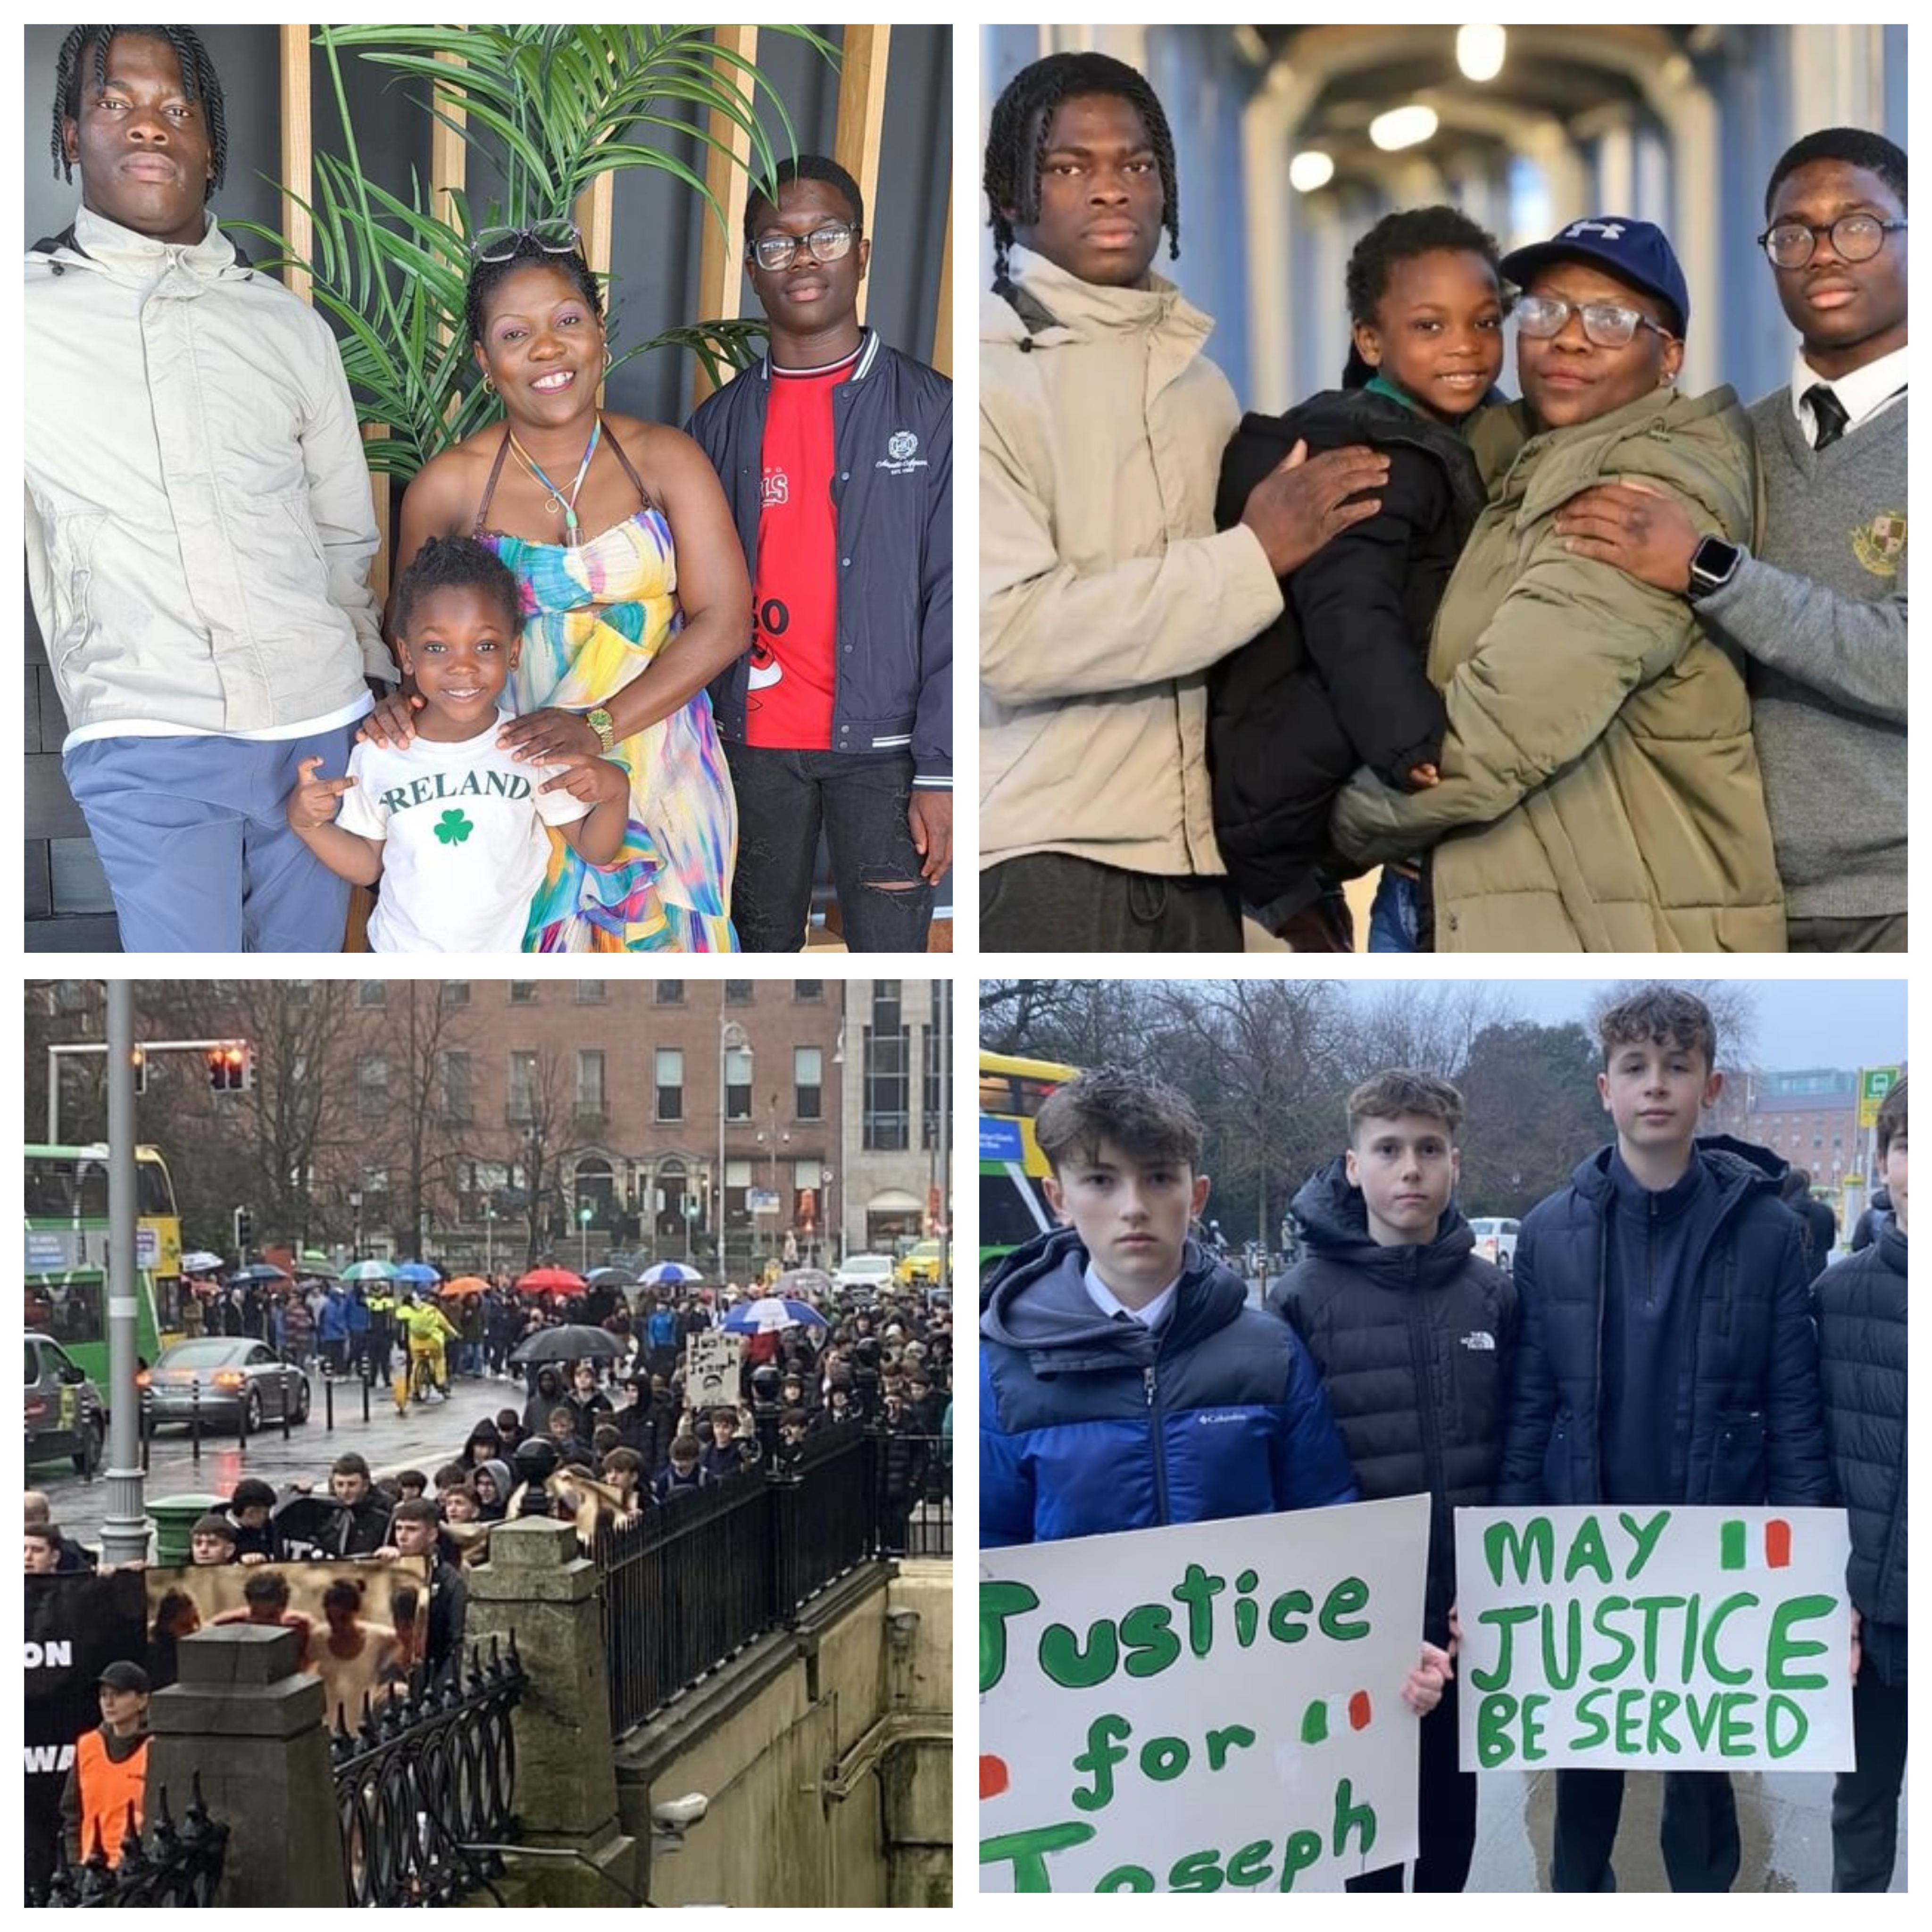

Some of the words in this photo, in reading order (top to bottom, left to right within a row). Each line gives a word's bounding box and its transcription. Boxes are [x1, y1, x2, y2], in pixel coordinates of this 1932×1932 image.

[1483, 1510, 1672, 1587] MAY
[979, 1563, 1371, 1694] Justice
[1471, 1591, 1838, 1692] JUSTICE
[1072, 1714, 1256, 1811] for
[1478, 1692, 1550, 1768] BE
[1569, 1688, 1809, 1759] SERVED
[979, 1778, 1376, 1893] Joseph
